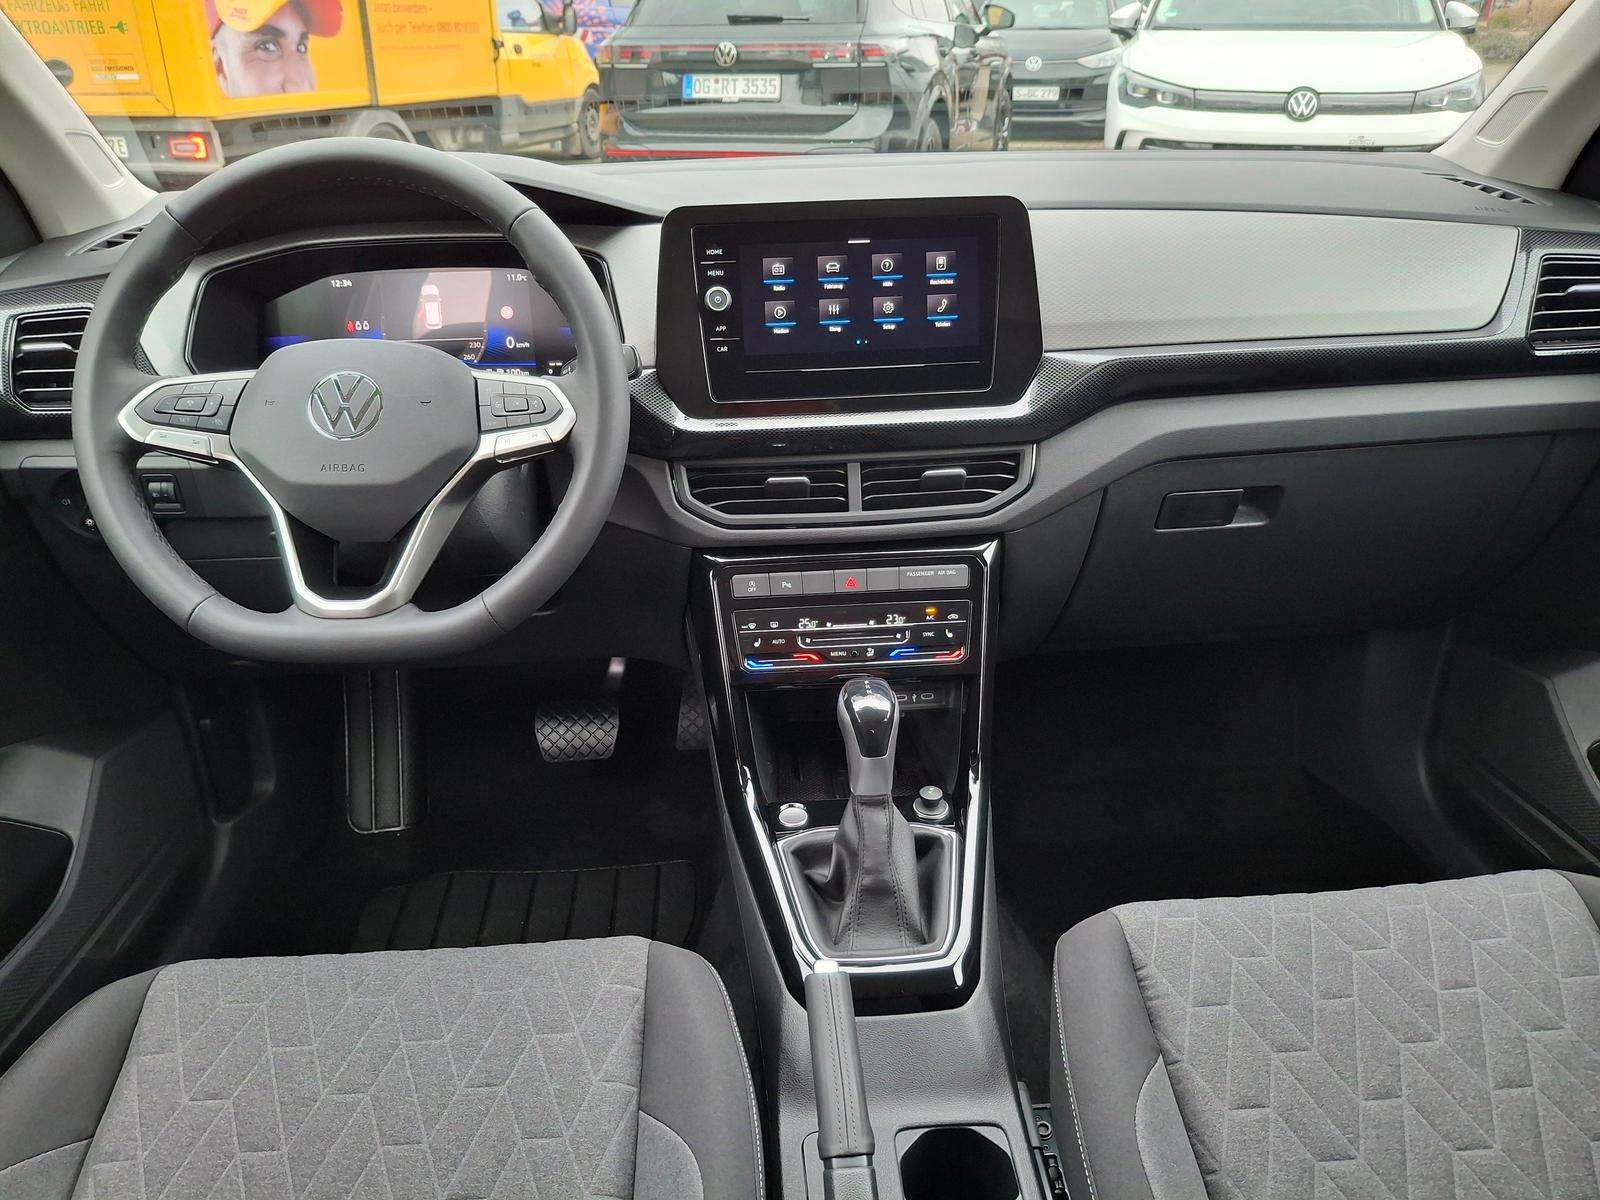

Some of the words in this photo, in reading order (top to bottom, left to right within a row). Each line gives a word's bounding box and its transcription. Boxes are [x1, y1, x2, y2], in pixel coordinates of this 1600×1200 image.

[694, 79, 710, 94] OG
[721, 79, 739, 94] RT
[742, 79, 777, 95] 3535
[469, 341, 481, 349] 230
[506, 336, 515, 349] 0
[320, 463, 365, 473] AIRBAG
